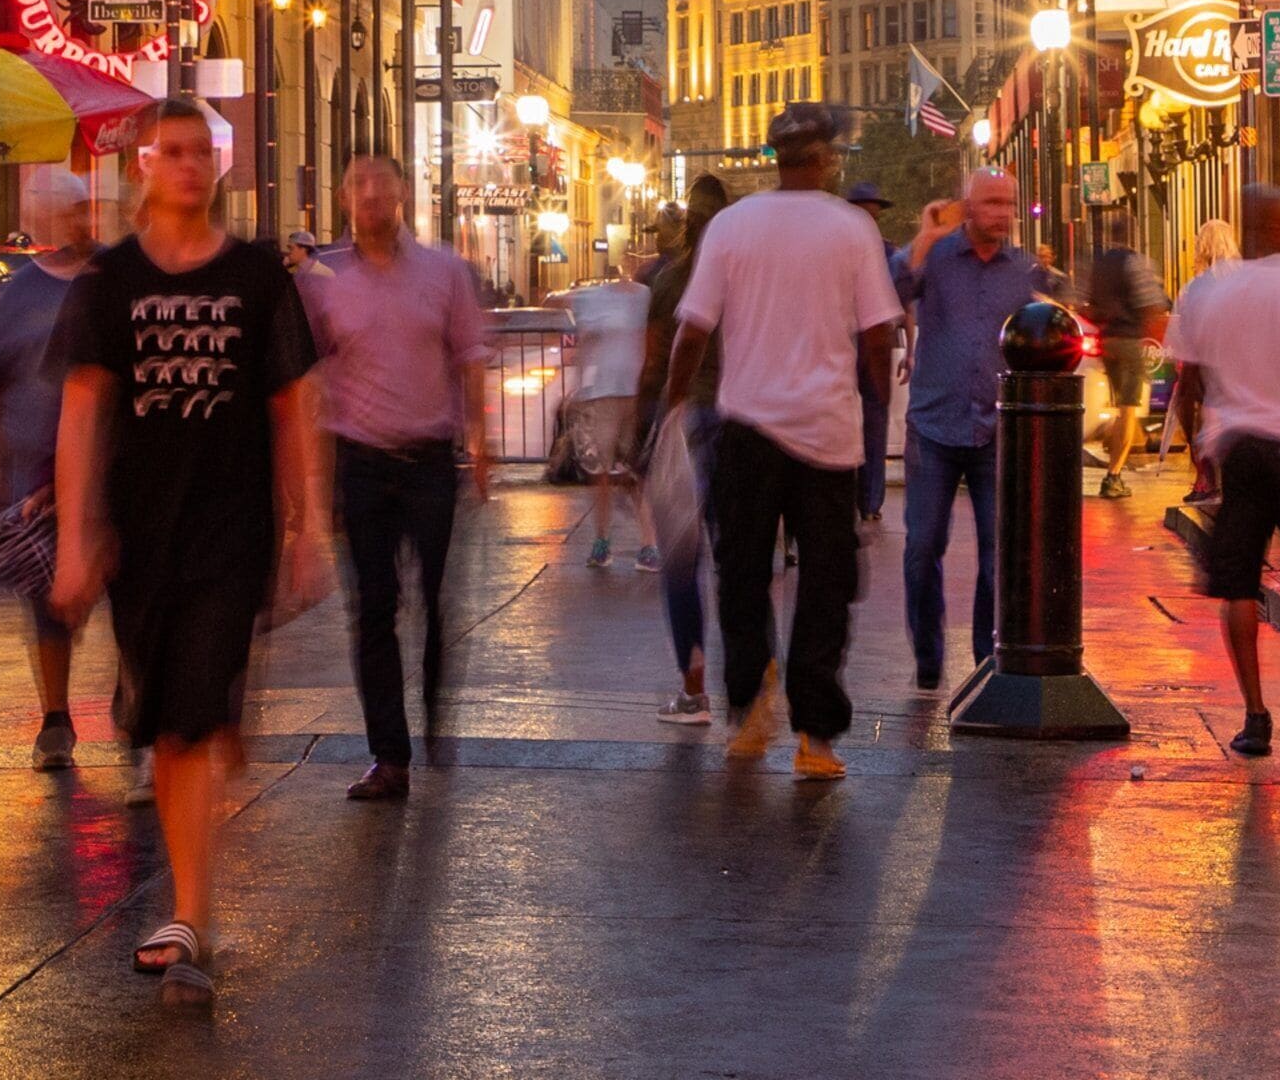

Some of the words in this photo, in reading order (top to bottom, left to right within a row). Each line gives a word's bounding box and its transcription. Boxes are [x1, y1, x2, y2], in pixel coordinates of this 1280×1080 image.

[93, 4, 160, 19] Iberville
[1144, 28, 1212, 58] Hard
[1195, 63, 1229, 77] CAFE
